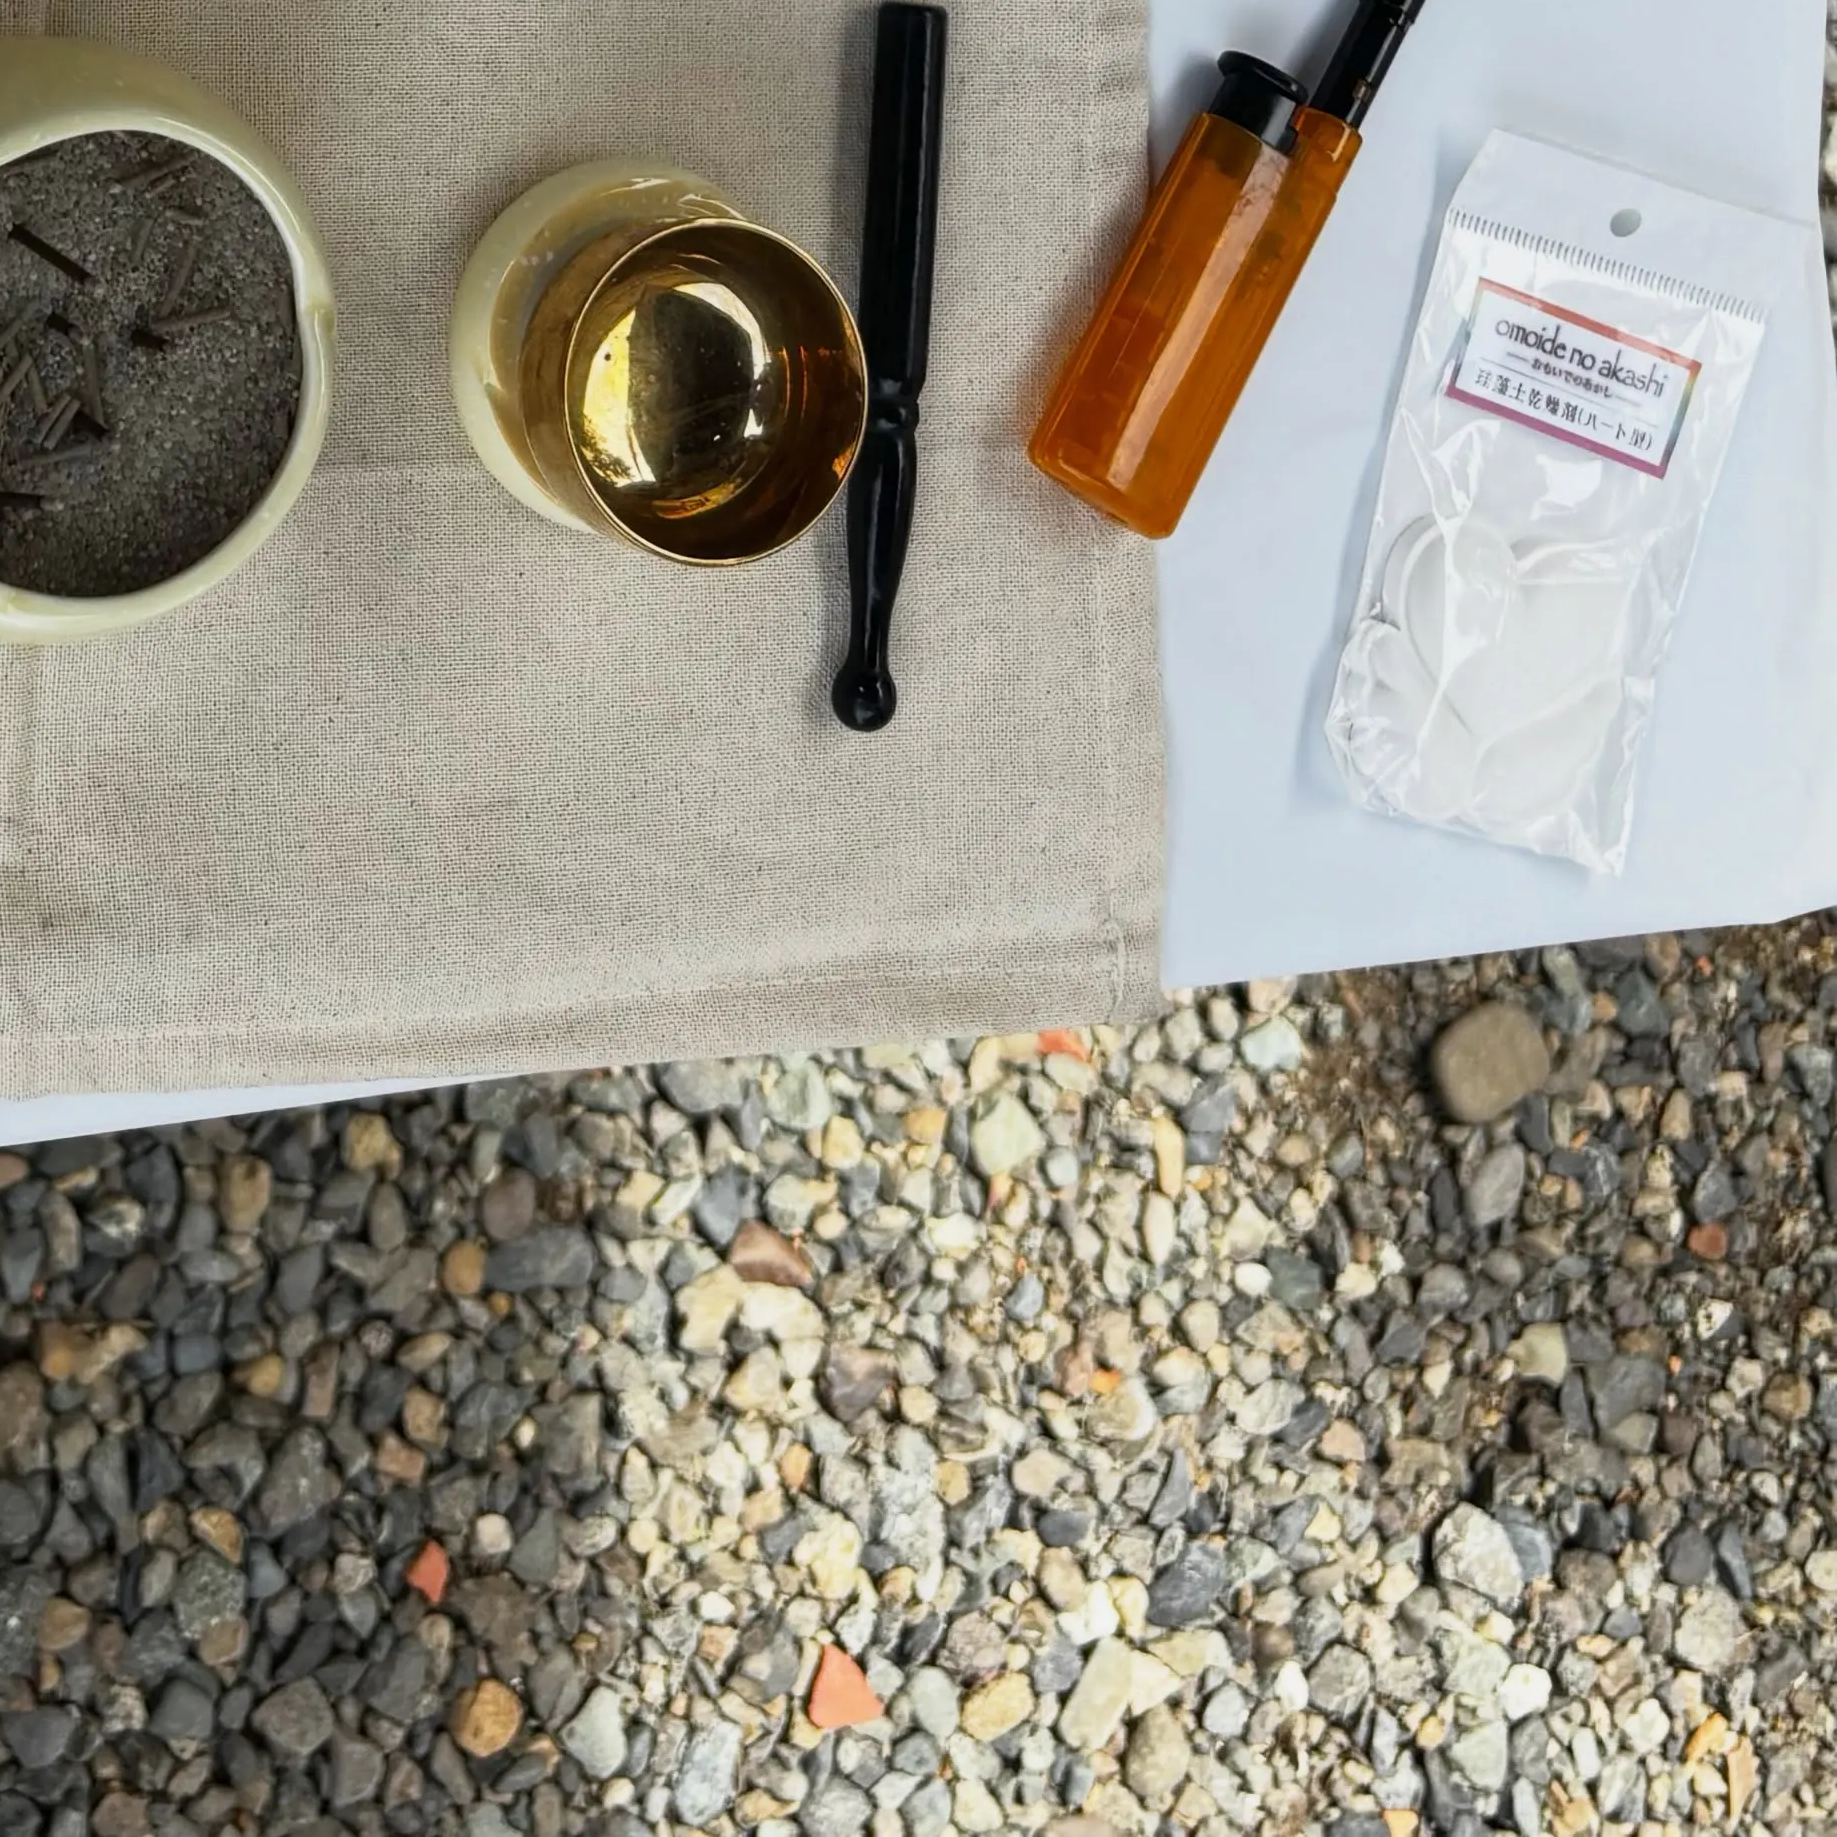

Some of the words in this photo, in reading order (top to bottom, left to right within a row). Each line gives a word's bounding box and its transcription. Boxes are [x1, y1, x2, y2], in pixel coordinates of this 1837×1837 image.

[1495, 320, 1567, 359] omoide
[1570, 347, 1596, 371] no
[1598, 349, 1669, 398] akashi
